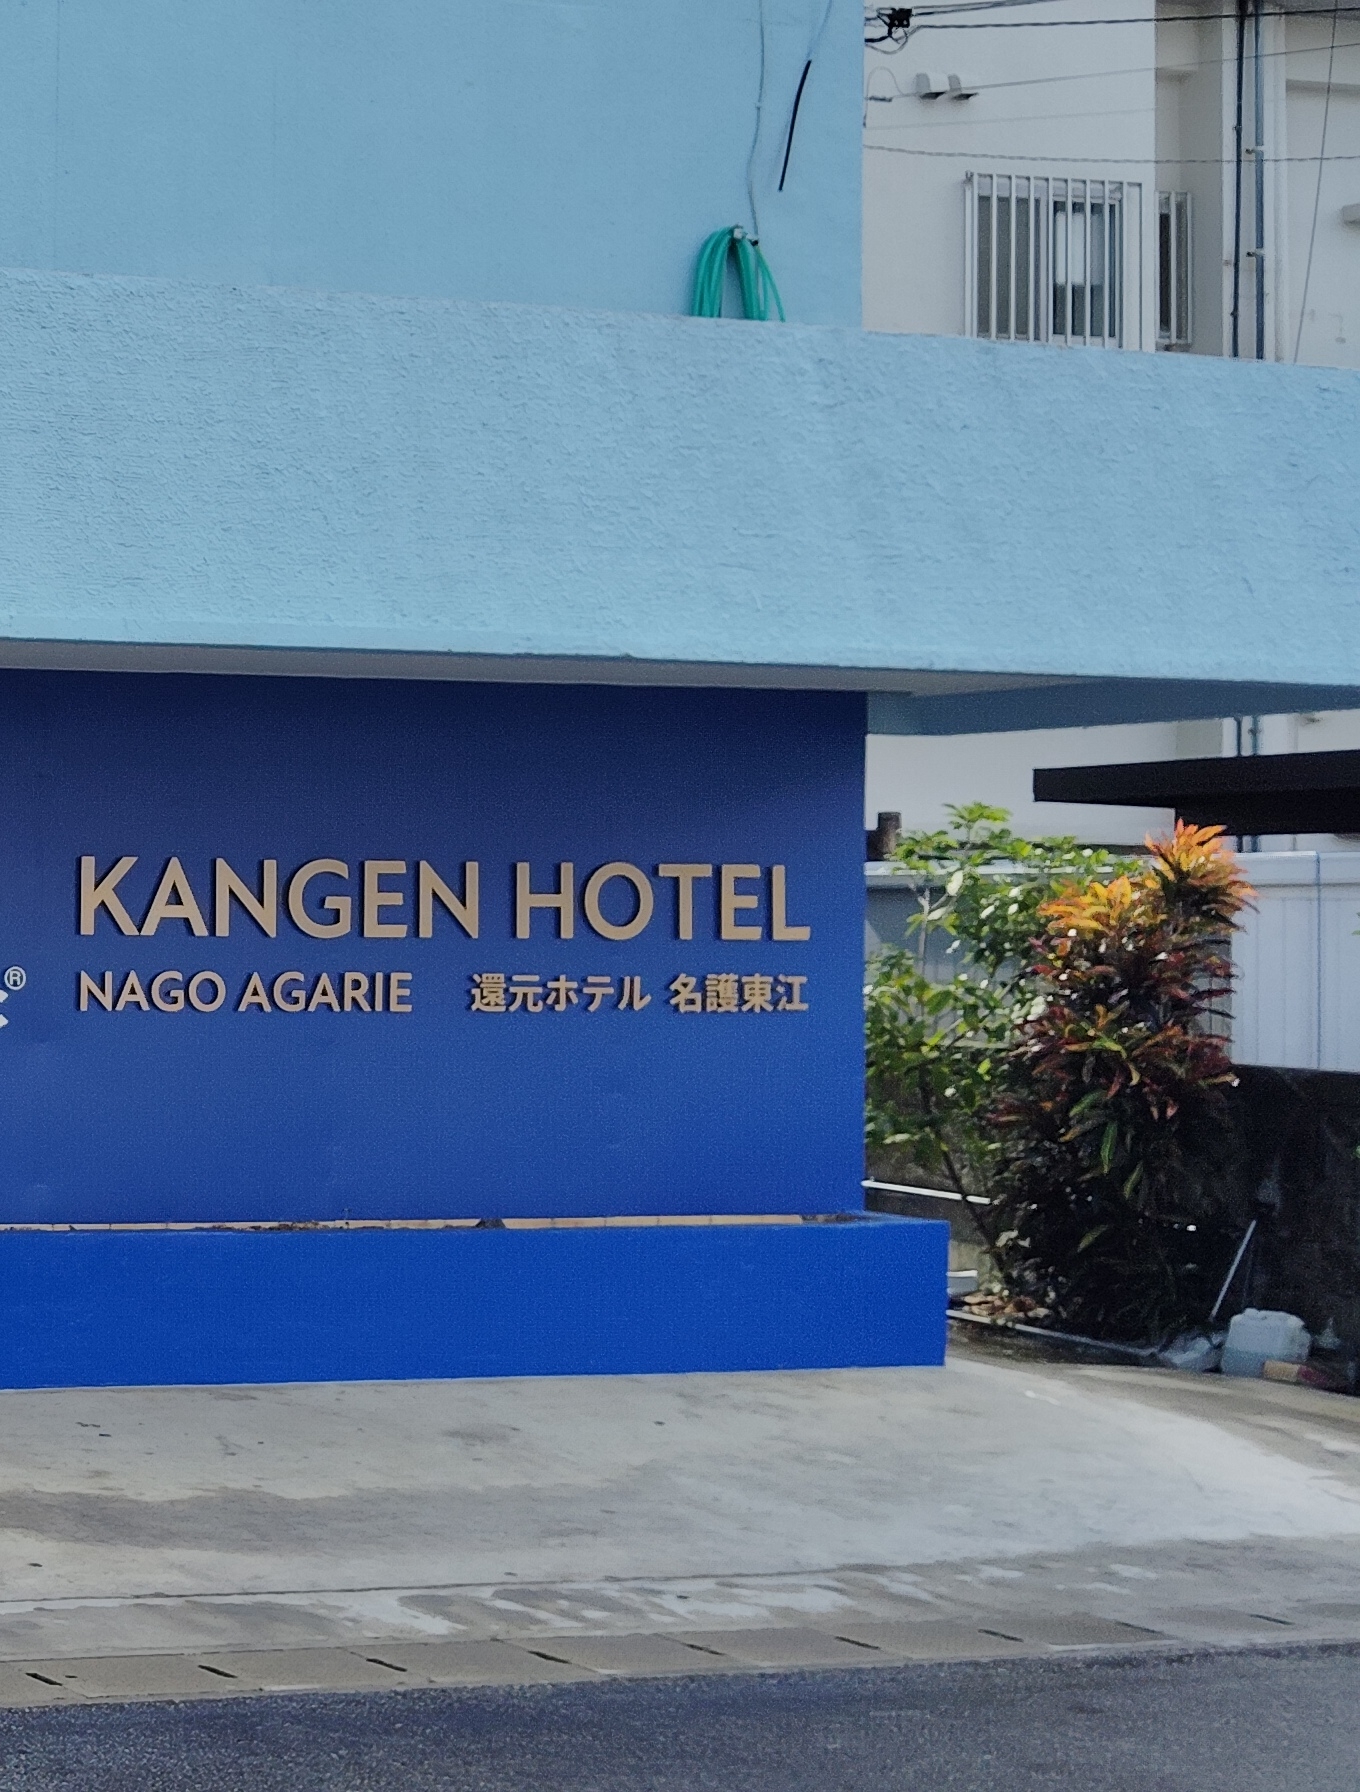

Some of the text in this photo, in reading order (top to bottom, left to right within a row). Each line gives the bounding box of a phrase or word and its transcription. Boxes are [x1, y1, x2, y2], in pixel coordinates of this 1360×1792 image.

[79, 855, 812, 942] KANGEN HOTEL
[79, 968, 810, 1014] NAGO AGARIE 還元ホテル 名護東江
